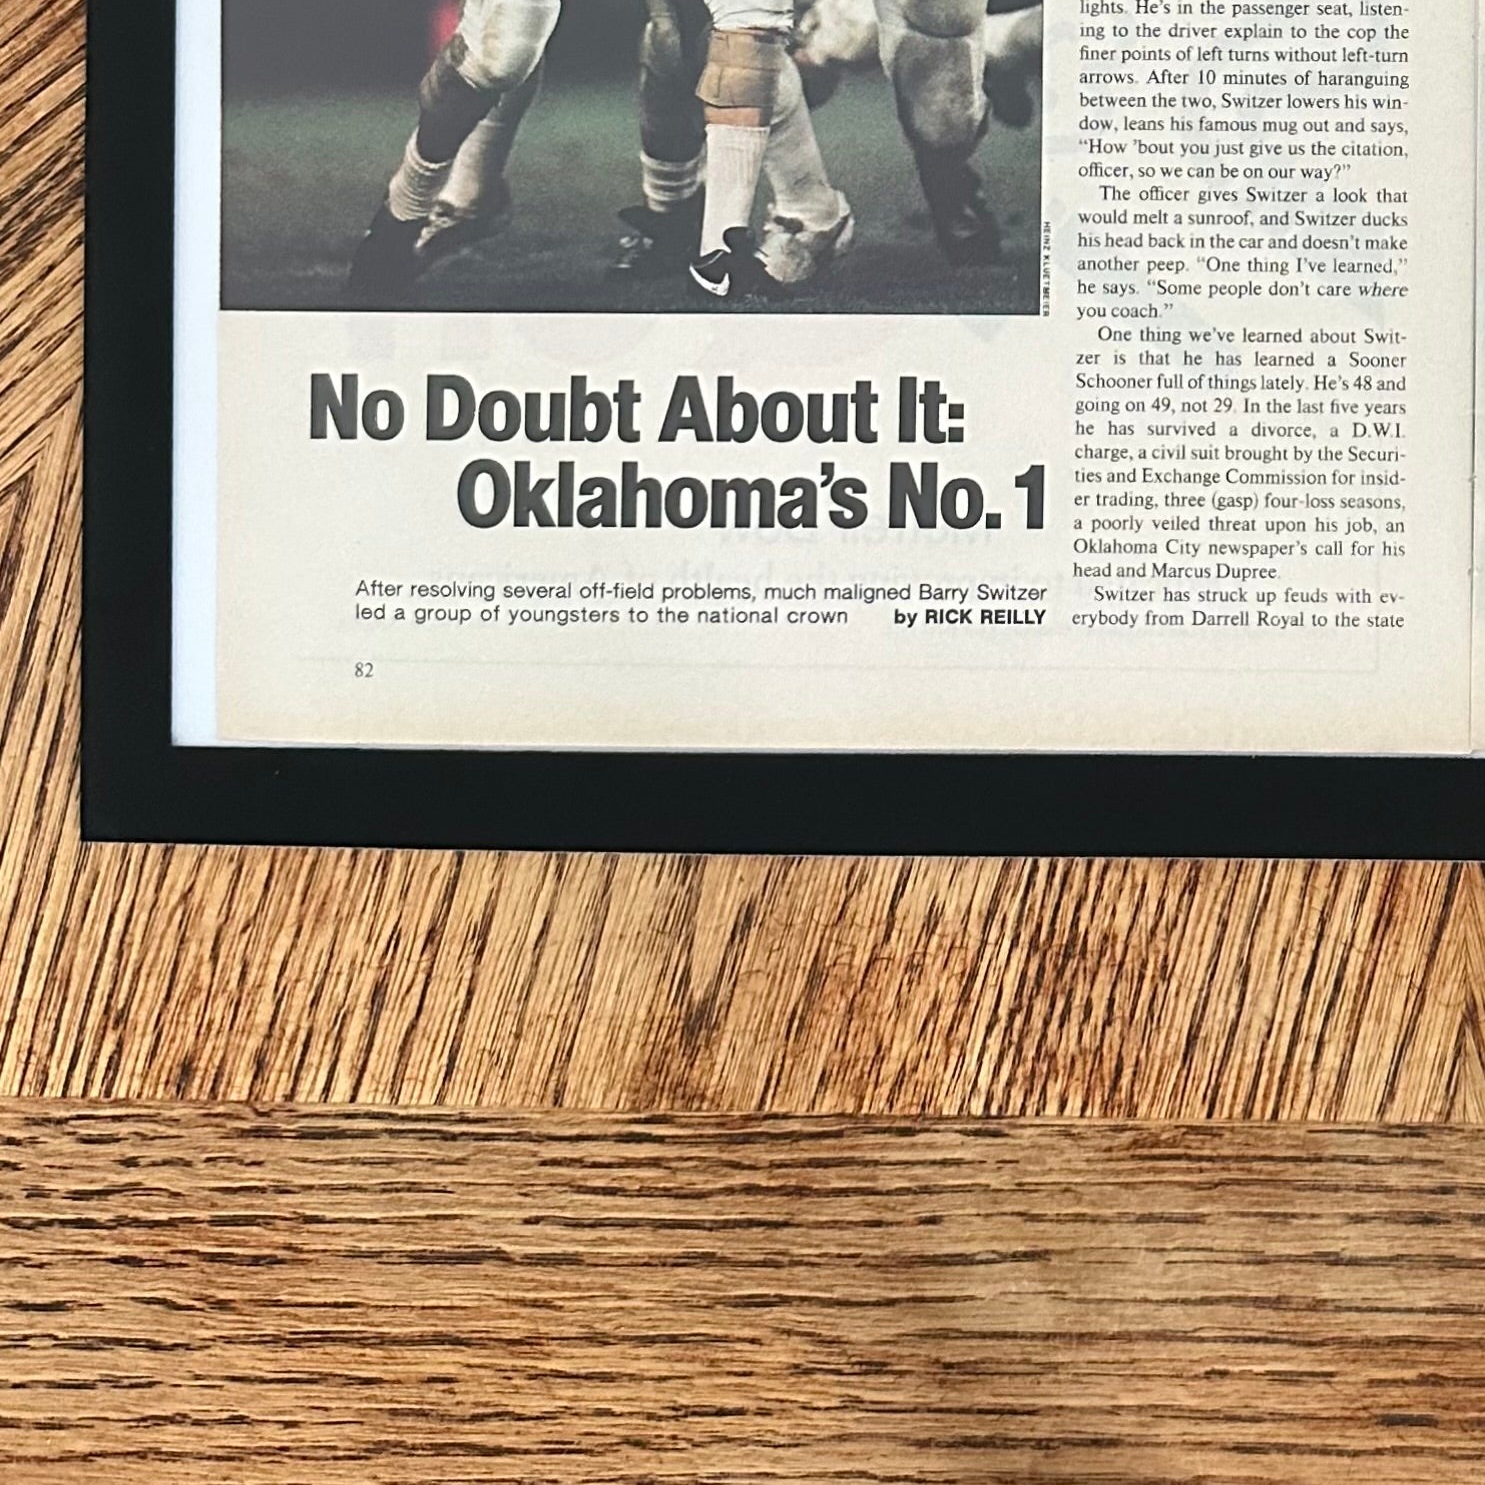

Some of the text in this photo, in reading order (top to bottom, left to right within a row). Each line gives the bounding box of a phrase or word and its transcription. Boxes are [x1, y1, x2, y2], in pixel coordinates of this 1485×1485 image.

[1079, 69, 1409, 90] arrows. After 10 minutes of haranguing
[310, 374, 964, 444] No Doubt About It:
[1075, 467, 1406, 487] ties and Exchange Commission for insid-
[457, 459, 1044, 529] Oklahoma's No. 1
[355, 580, 1048, 604] After resolving several off-field problems, much maligned Barry Switzer
[356, 603, 848, 626] led a group of youngsters to the national crown
[894, 608, 1046, 628] by RICK REILLY
[1072, 610, 1404, 629] erybody from Darrell Royal to the state
[354, 660, 375, 679] 82
